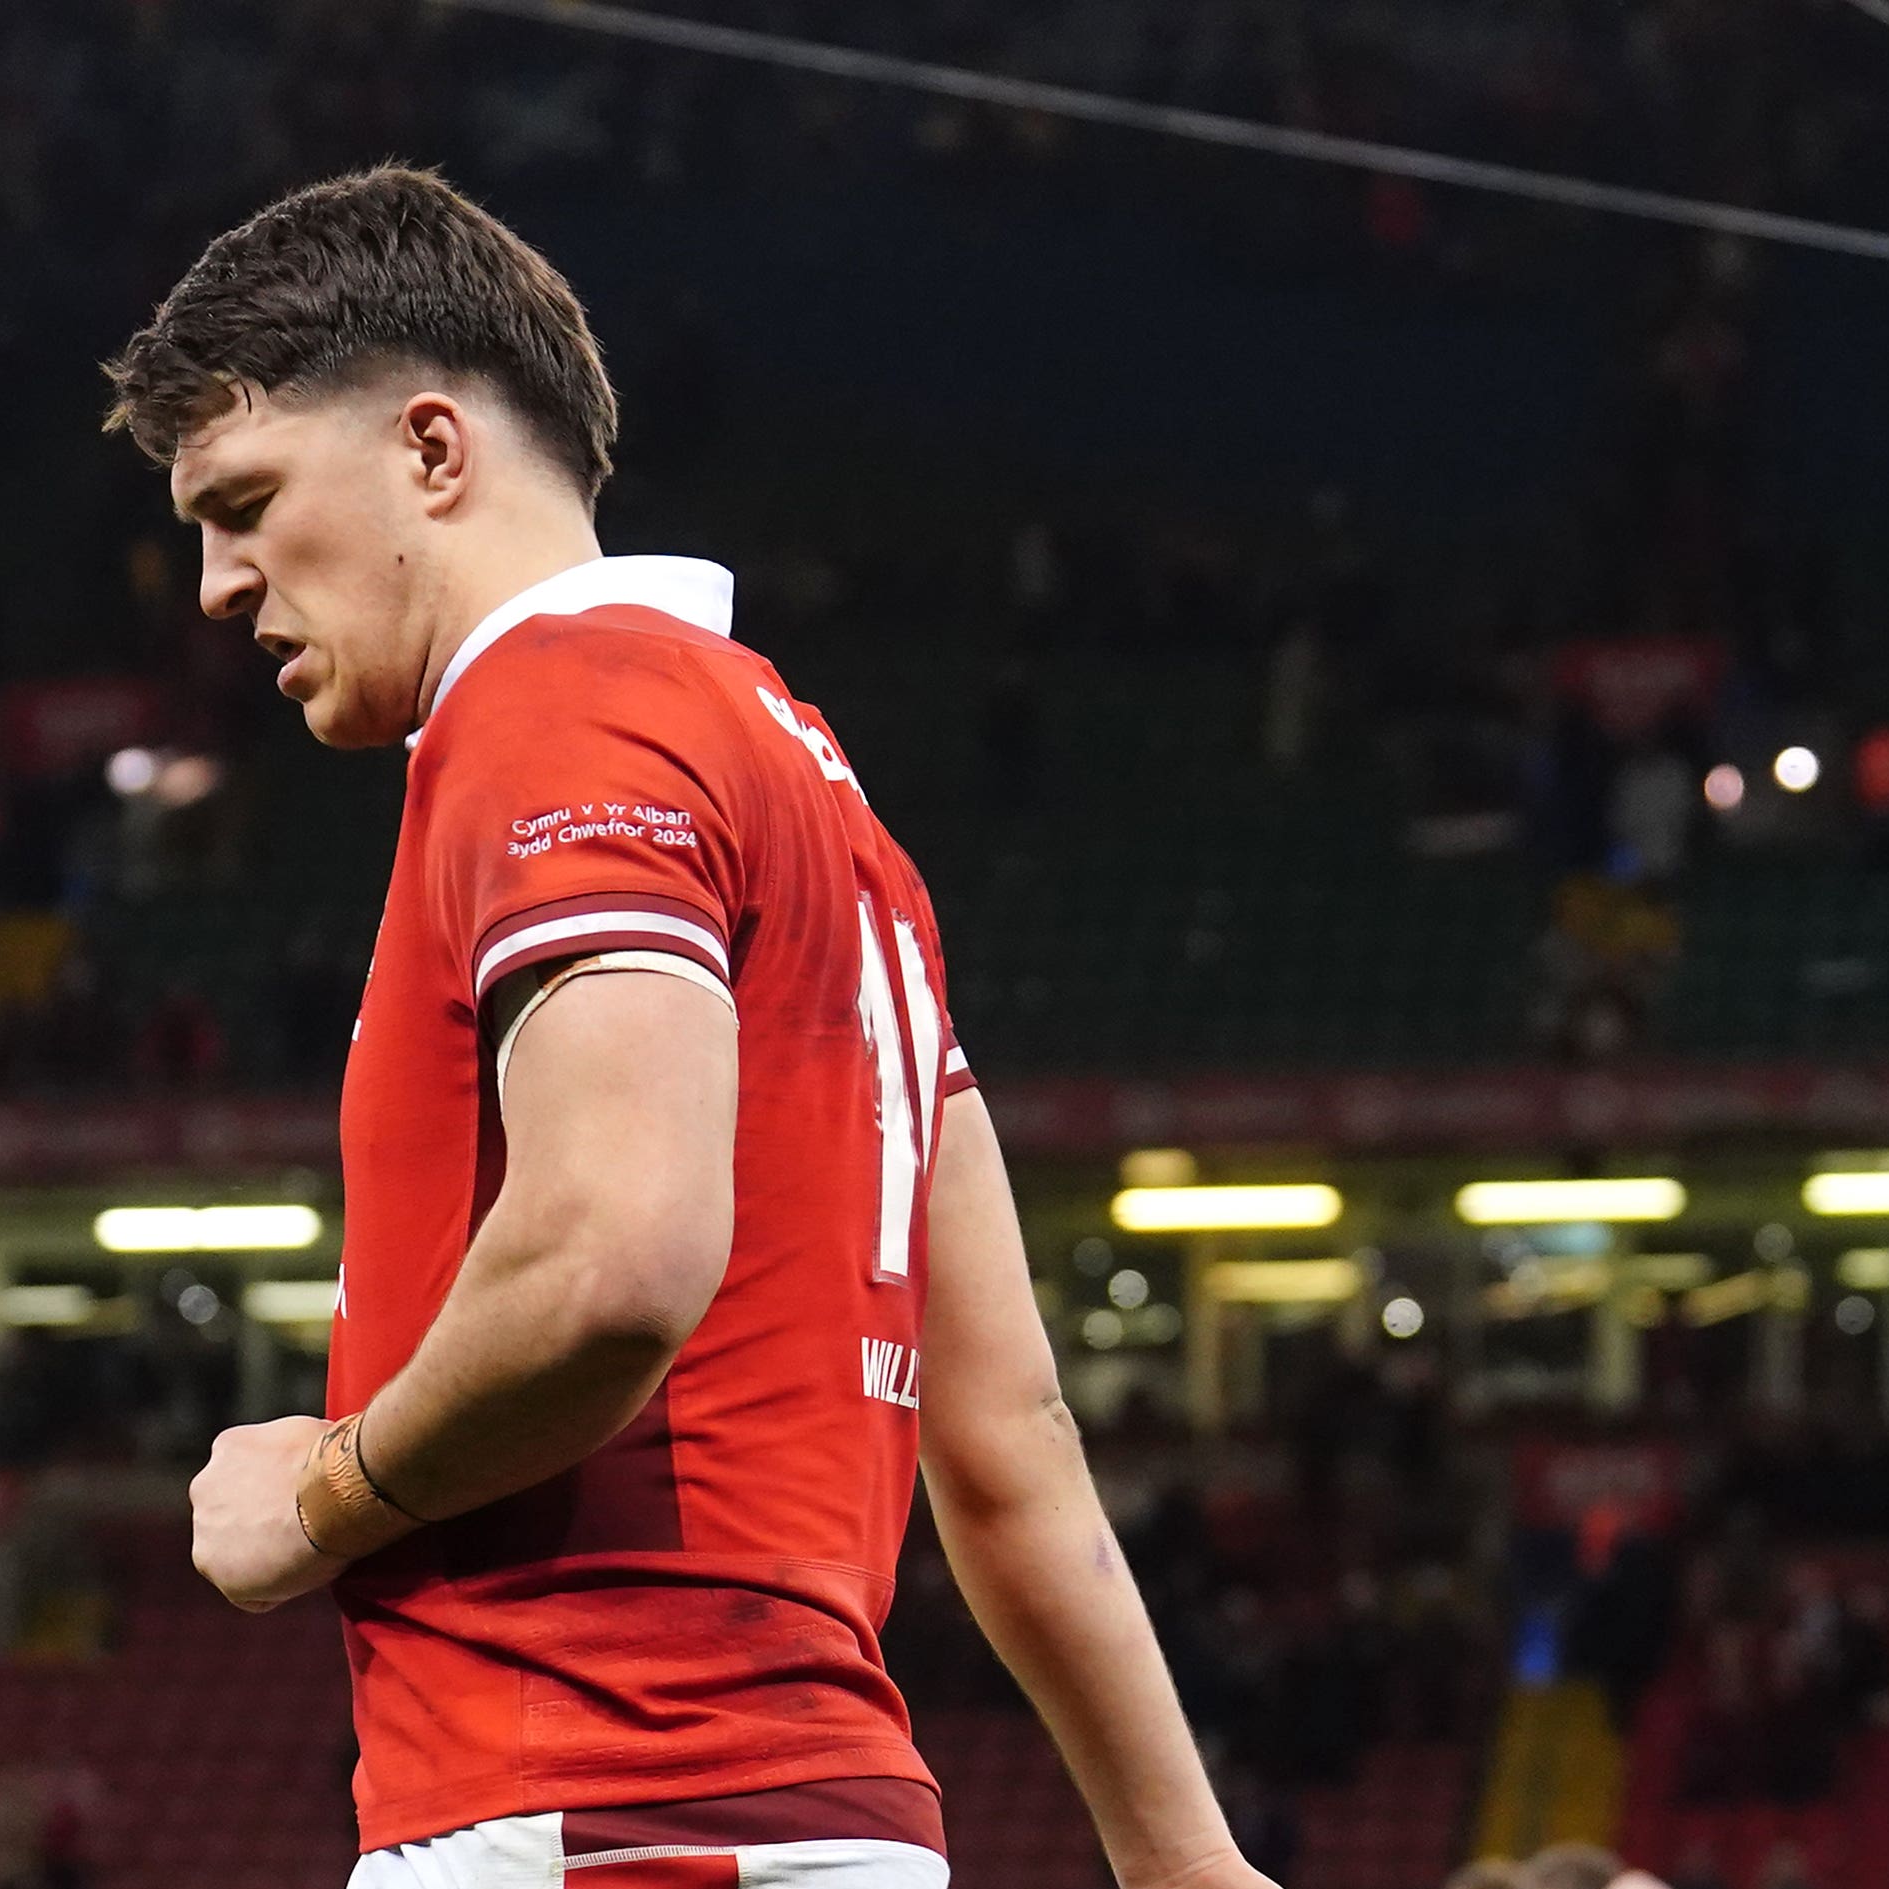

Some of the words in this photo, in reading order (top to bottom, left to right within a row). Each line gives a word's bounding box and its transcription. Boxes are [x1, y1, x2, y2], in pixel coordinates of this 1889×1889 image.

[507, 832, 552, 859] 3ydd
[557, 818, 646, 843] Chwefror
[652, 828, 698, 848] 2024
[512, 806, 571, 837] Cymru
[581, 803, 593, 815] v
[603, 802, 626, 816] Yr
[633, 805, 691, 825] Alban
